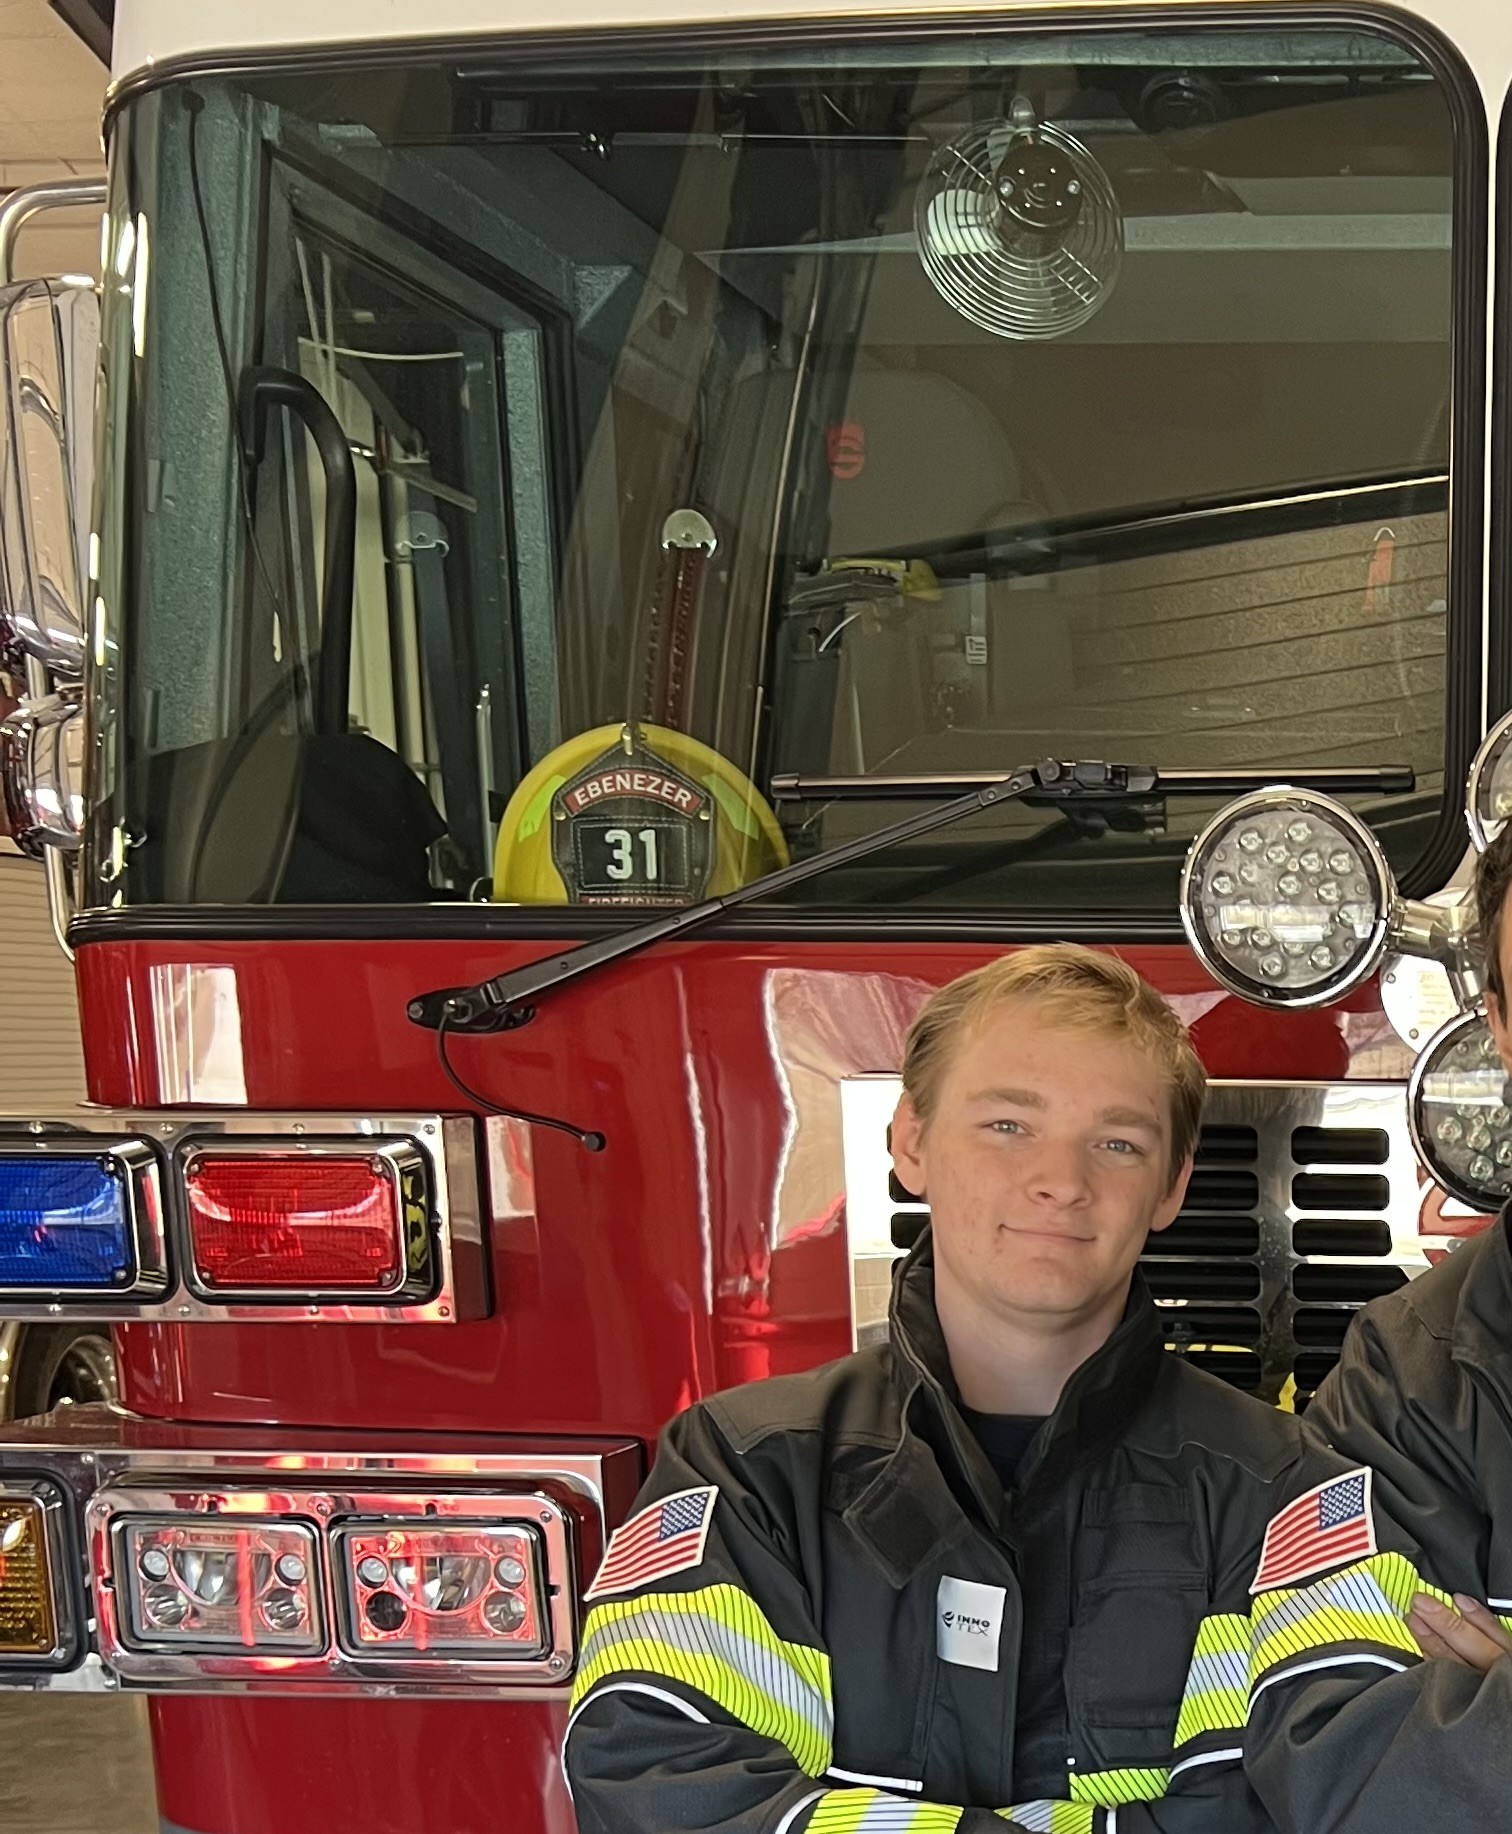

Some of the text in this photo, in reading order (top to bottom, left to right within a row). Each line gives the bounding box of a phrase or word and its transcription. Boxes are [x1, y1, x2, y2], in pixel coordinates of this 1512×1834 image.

[574, 773, 692, 807] EBENEZER
[604, 829, 658, 879] 31
[956, 1621, 988, 1637] TEX
[957, 1614, 990, 1628] INNO
